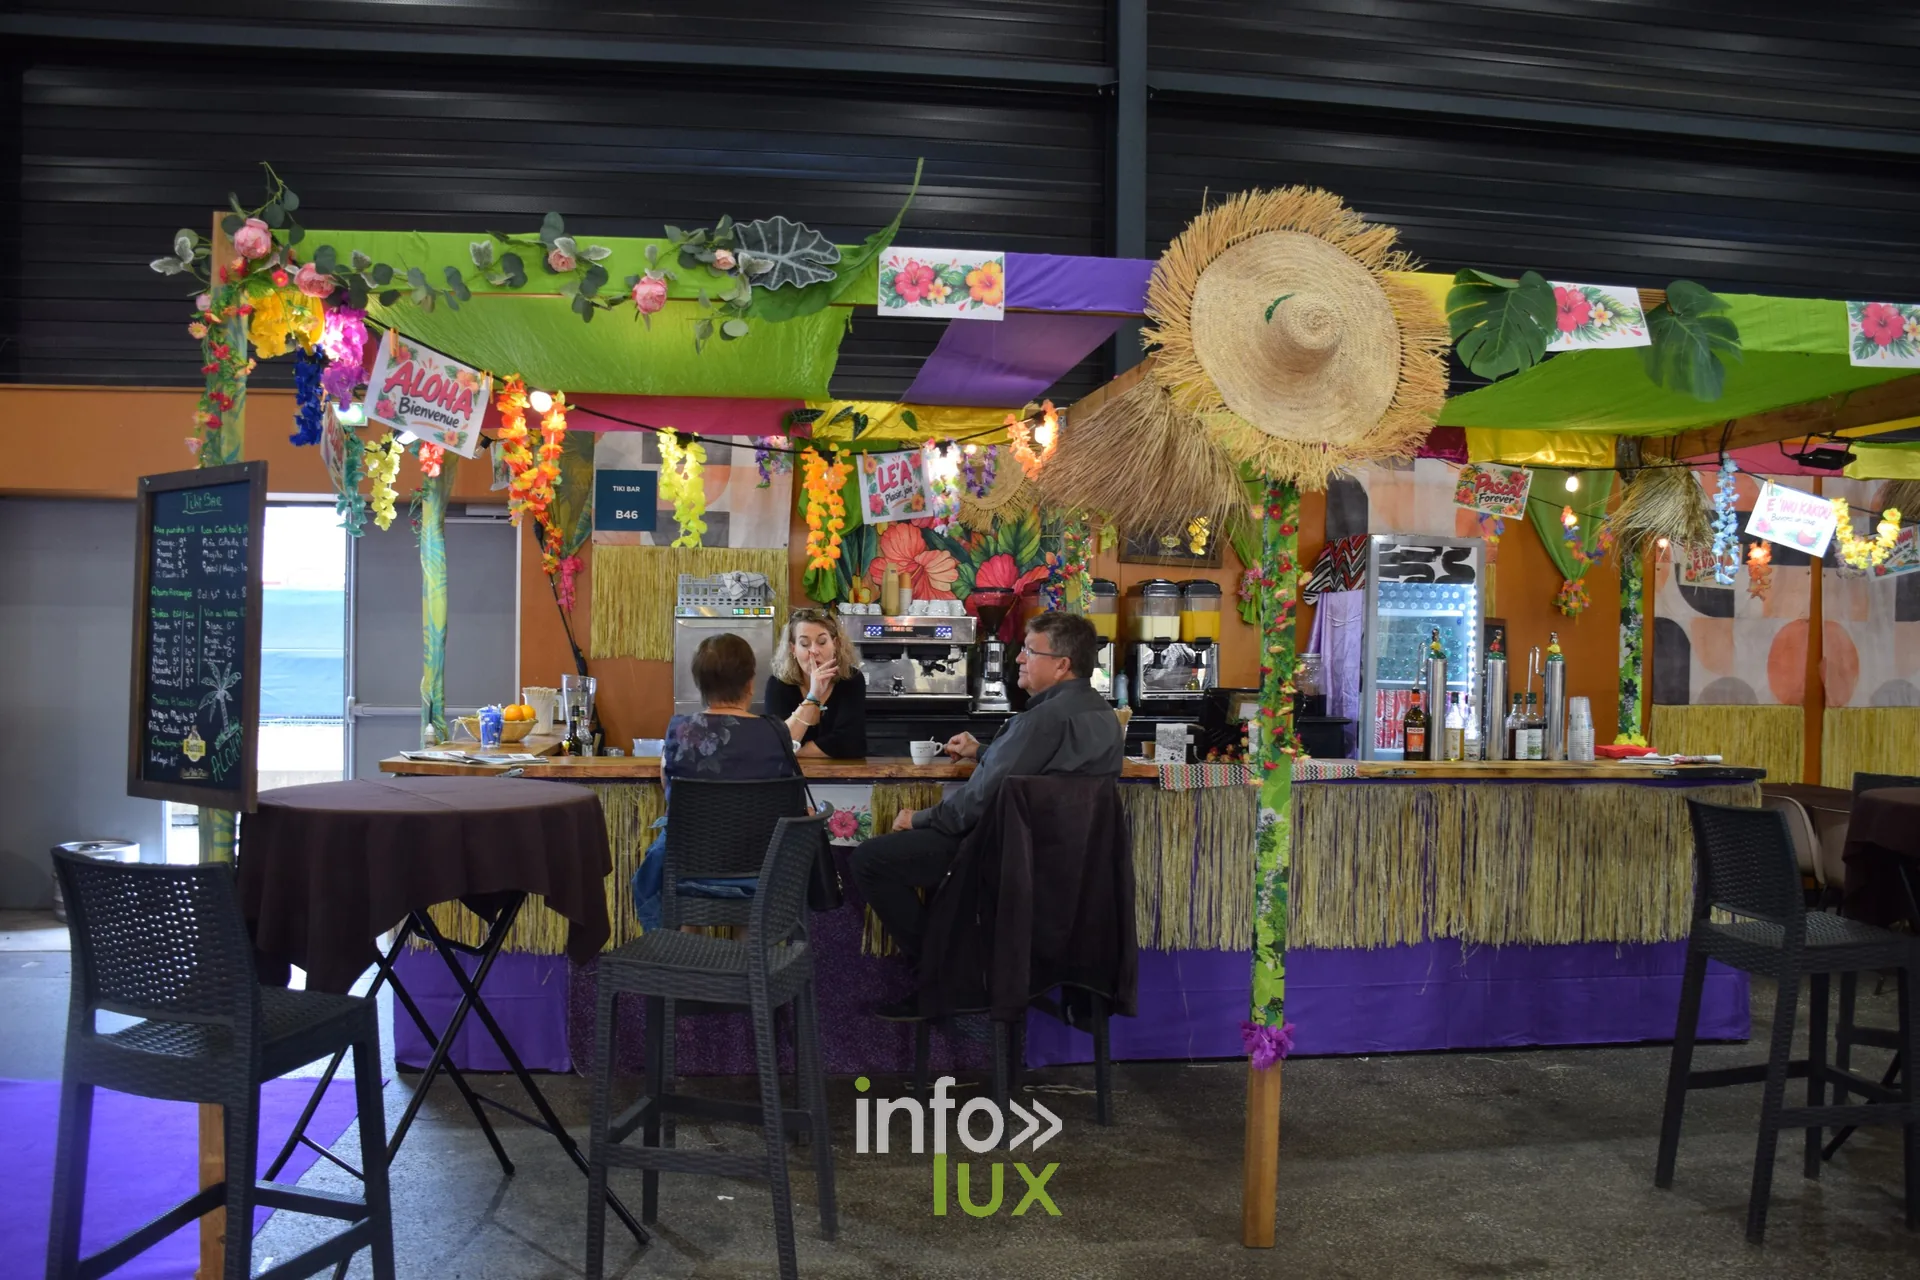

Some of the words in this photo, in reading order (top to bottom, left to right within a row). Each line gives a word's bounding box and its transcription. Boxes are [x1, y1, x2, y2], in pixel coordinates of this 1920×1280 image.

[383, 361, 473, 420] ALOHA
[398, 397, 460, 428] Bienvenue
[1475, 473, 1522, 498] Pascal
[1479, 493, 1515, 503] Forever
[1767, 498, 1777, 512] E
[615, 510, 638, 520] B46
